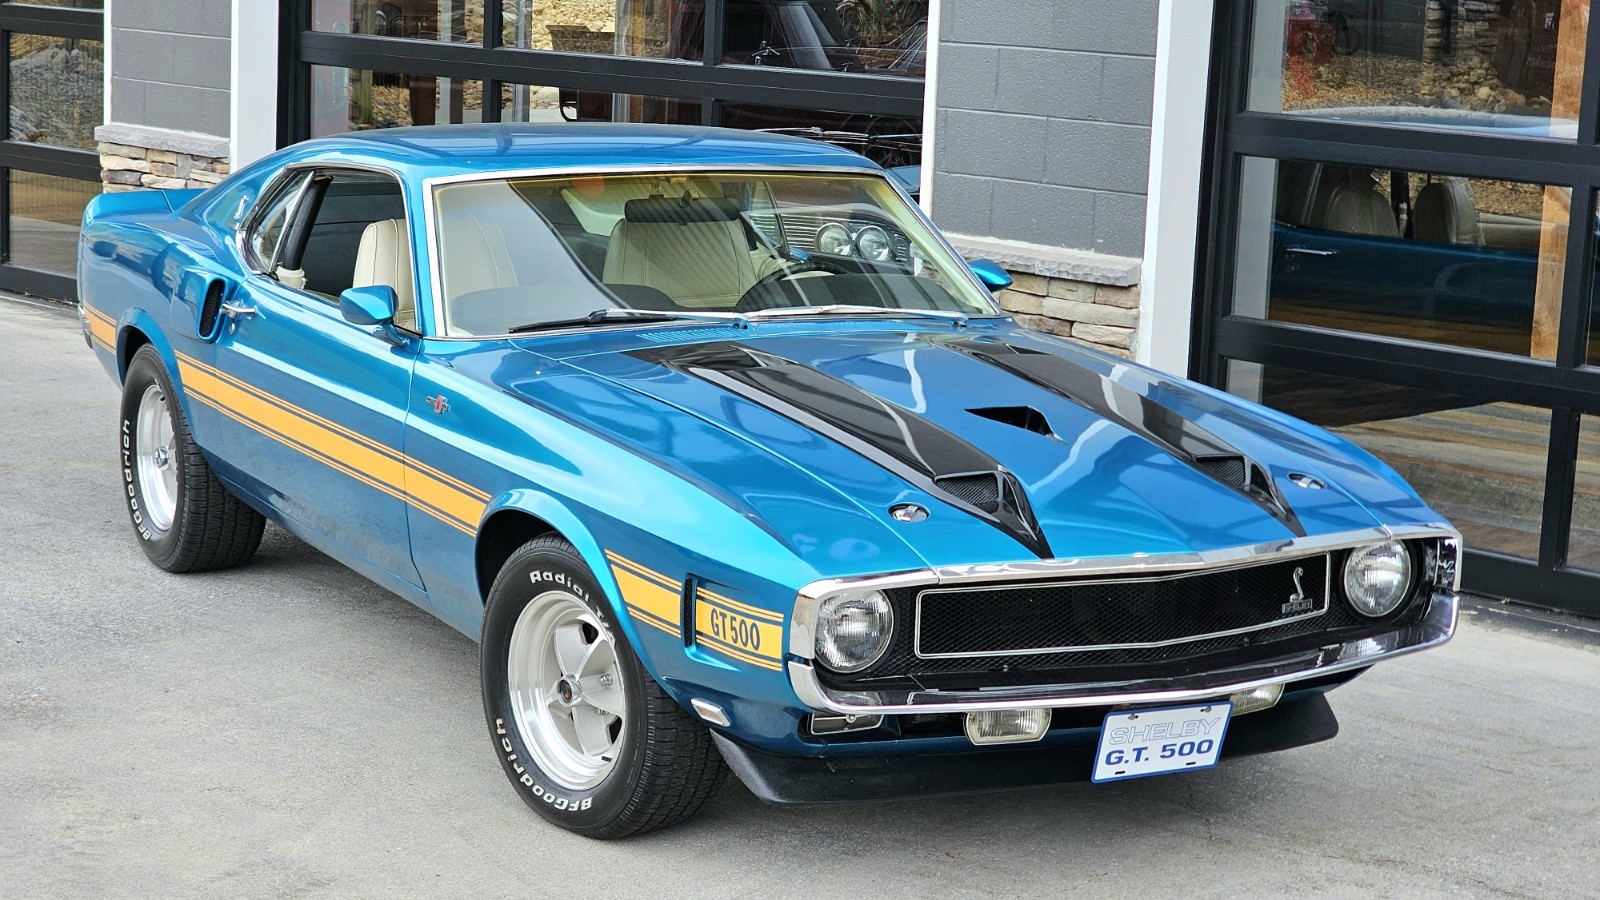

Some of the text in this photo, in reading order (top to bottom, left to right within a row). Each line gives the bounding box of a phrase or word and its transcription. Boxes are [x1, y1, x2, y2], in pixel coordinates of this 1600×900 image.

[122, 419, 151, 541] BFGoodrich
[529, 570, 590, 602] Radial
[710, 607, 760, 651] GT500
[1109, 717, 1221, 745] SHELBY
[496, 718, 593, 811] BFGoodrich
[1105, 739, 1214, 765] G.T. 500
